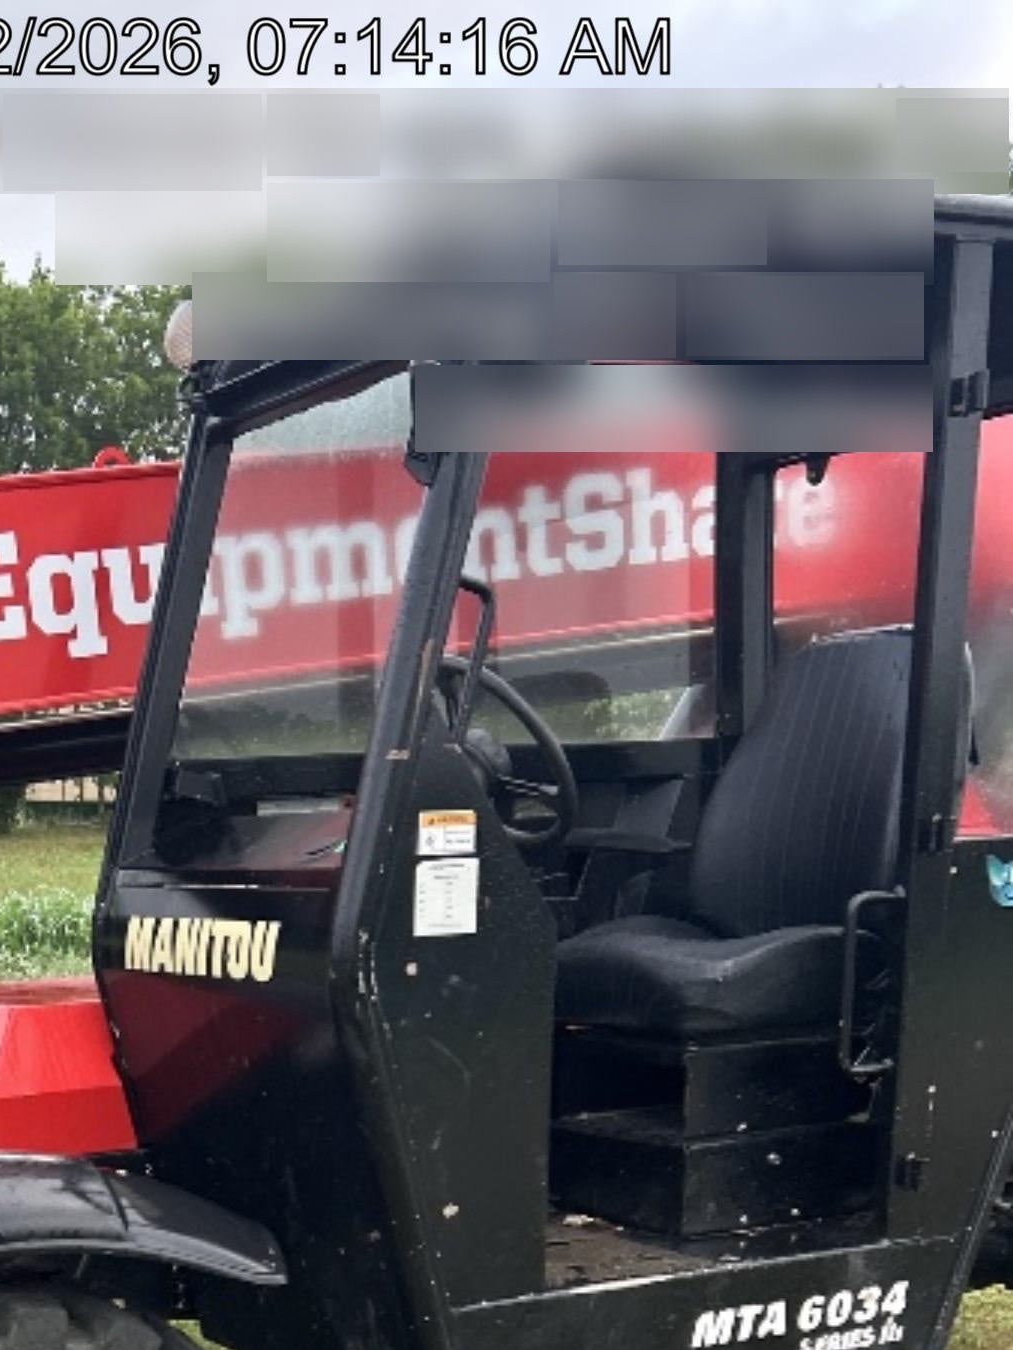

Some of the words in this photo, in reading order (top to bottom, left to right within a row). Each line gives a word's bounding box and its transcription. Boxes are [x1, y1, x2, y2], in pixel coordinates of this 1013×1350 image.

[124, 914, 282, 983] MANITOU
[690, 1298, 788, 1349] MTA
[797, 1279, 910, 1332] 6034
